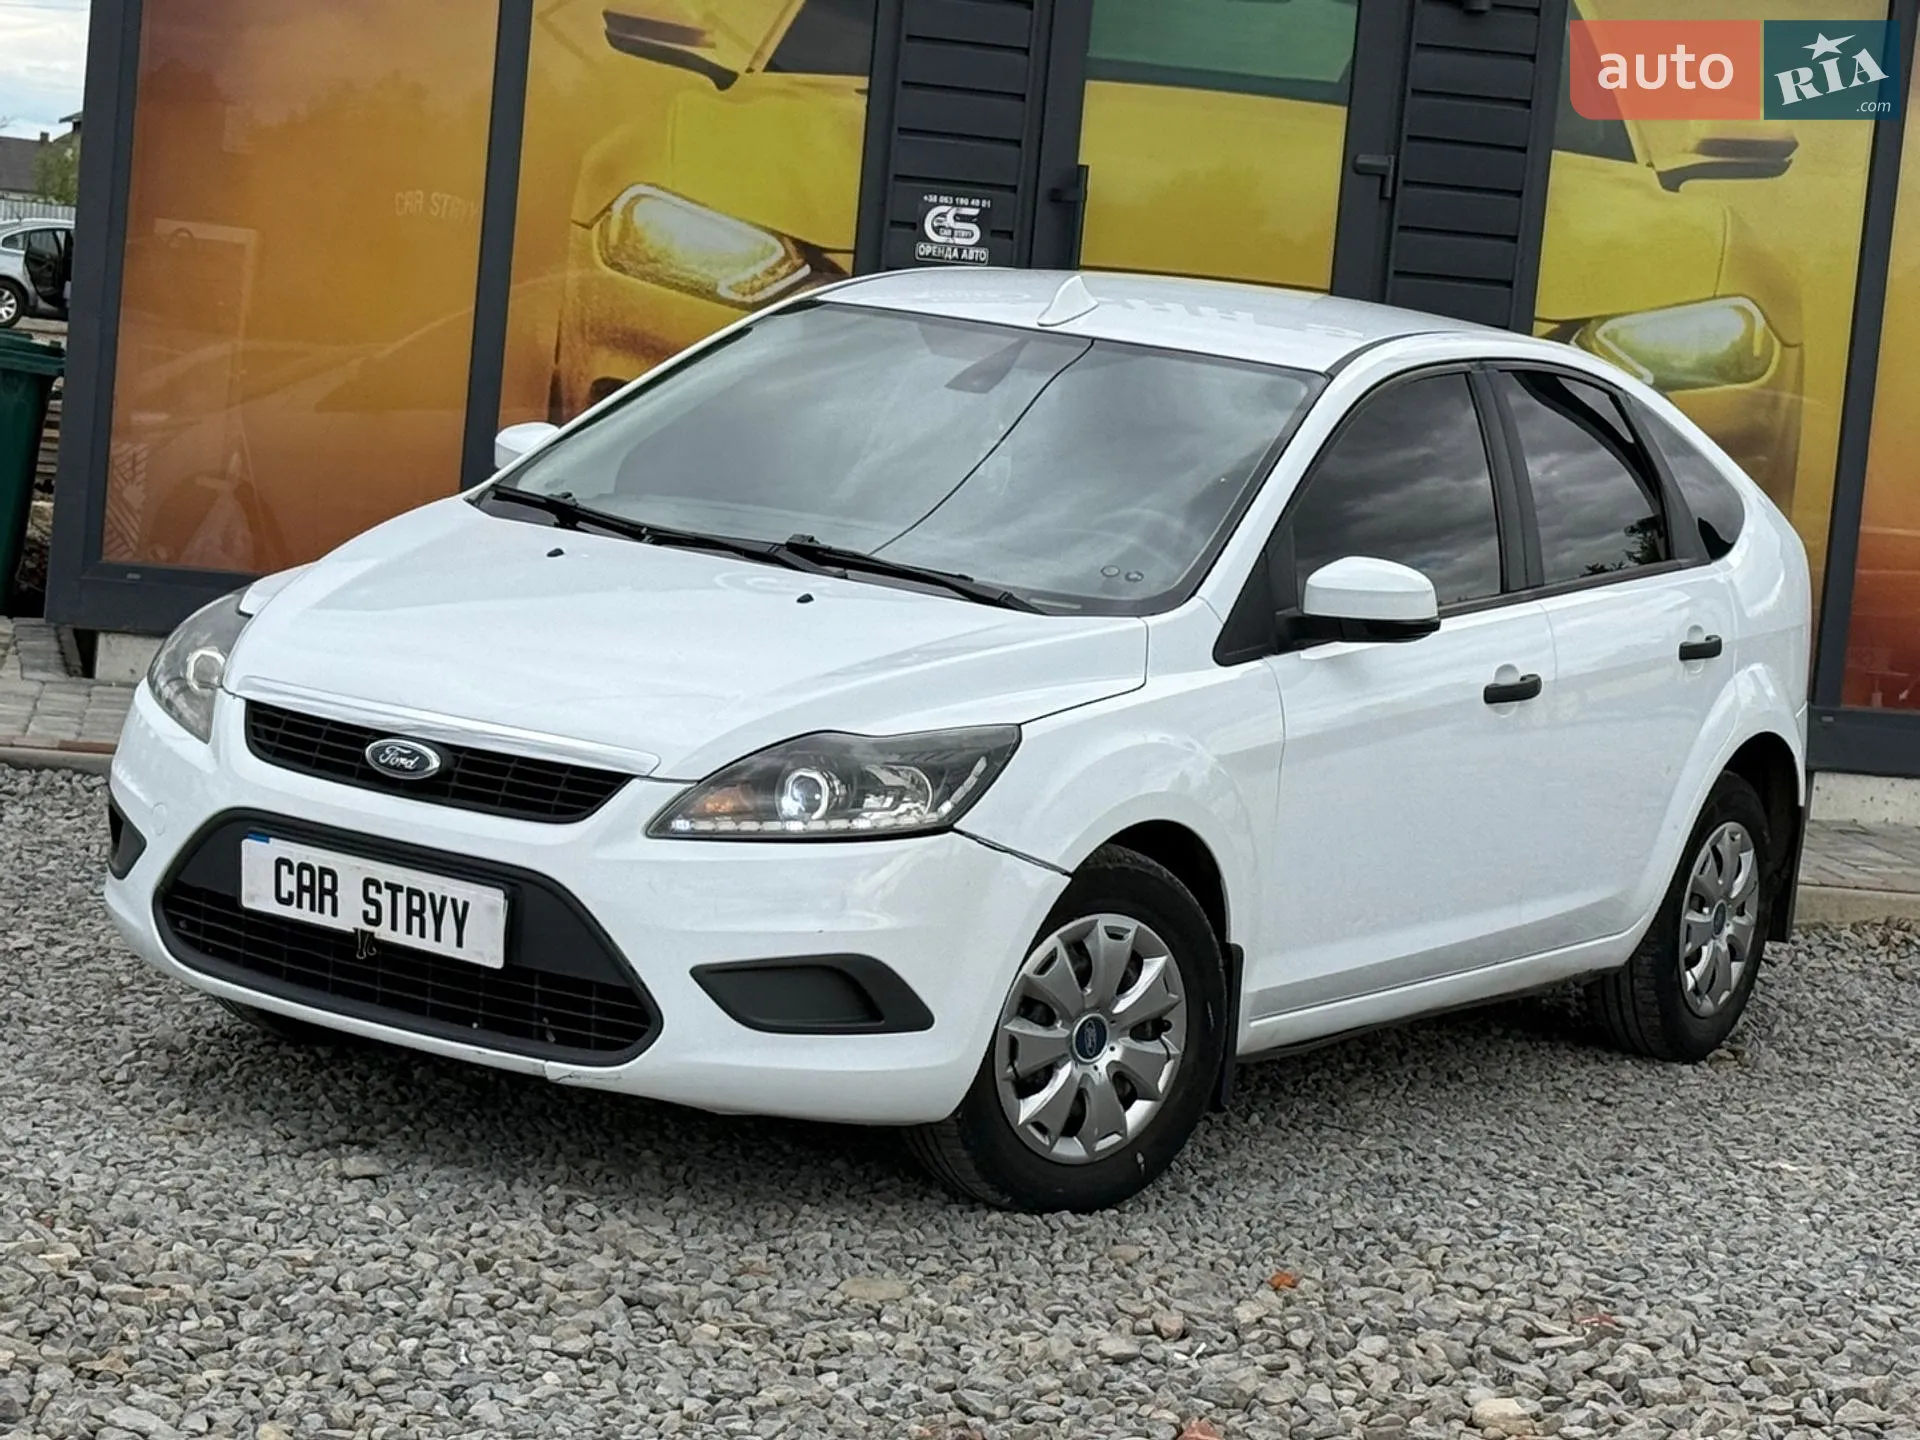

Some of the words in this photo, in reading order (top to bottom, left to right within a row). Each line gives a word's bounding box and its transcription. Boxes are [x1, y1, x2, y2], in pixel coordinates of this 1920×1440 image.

[918, 244, 959, 260] ОРЕНДА
[961, 248, 987, 262] АВТО
[379, 745, 420, 770] Ford
[274, 856, 338, 918] CAR
[362, 876, 470, 949] STRYY
